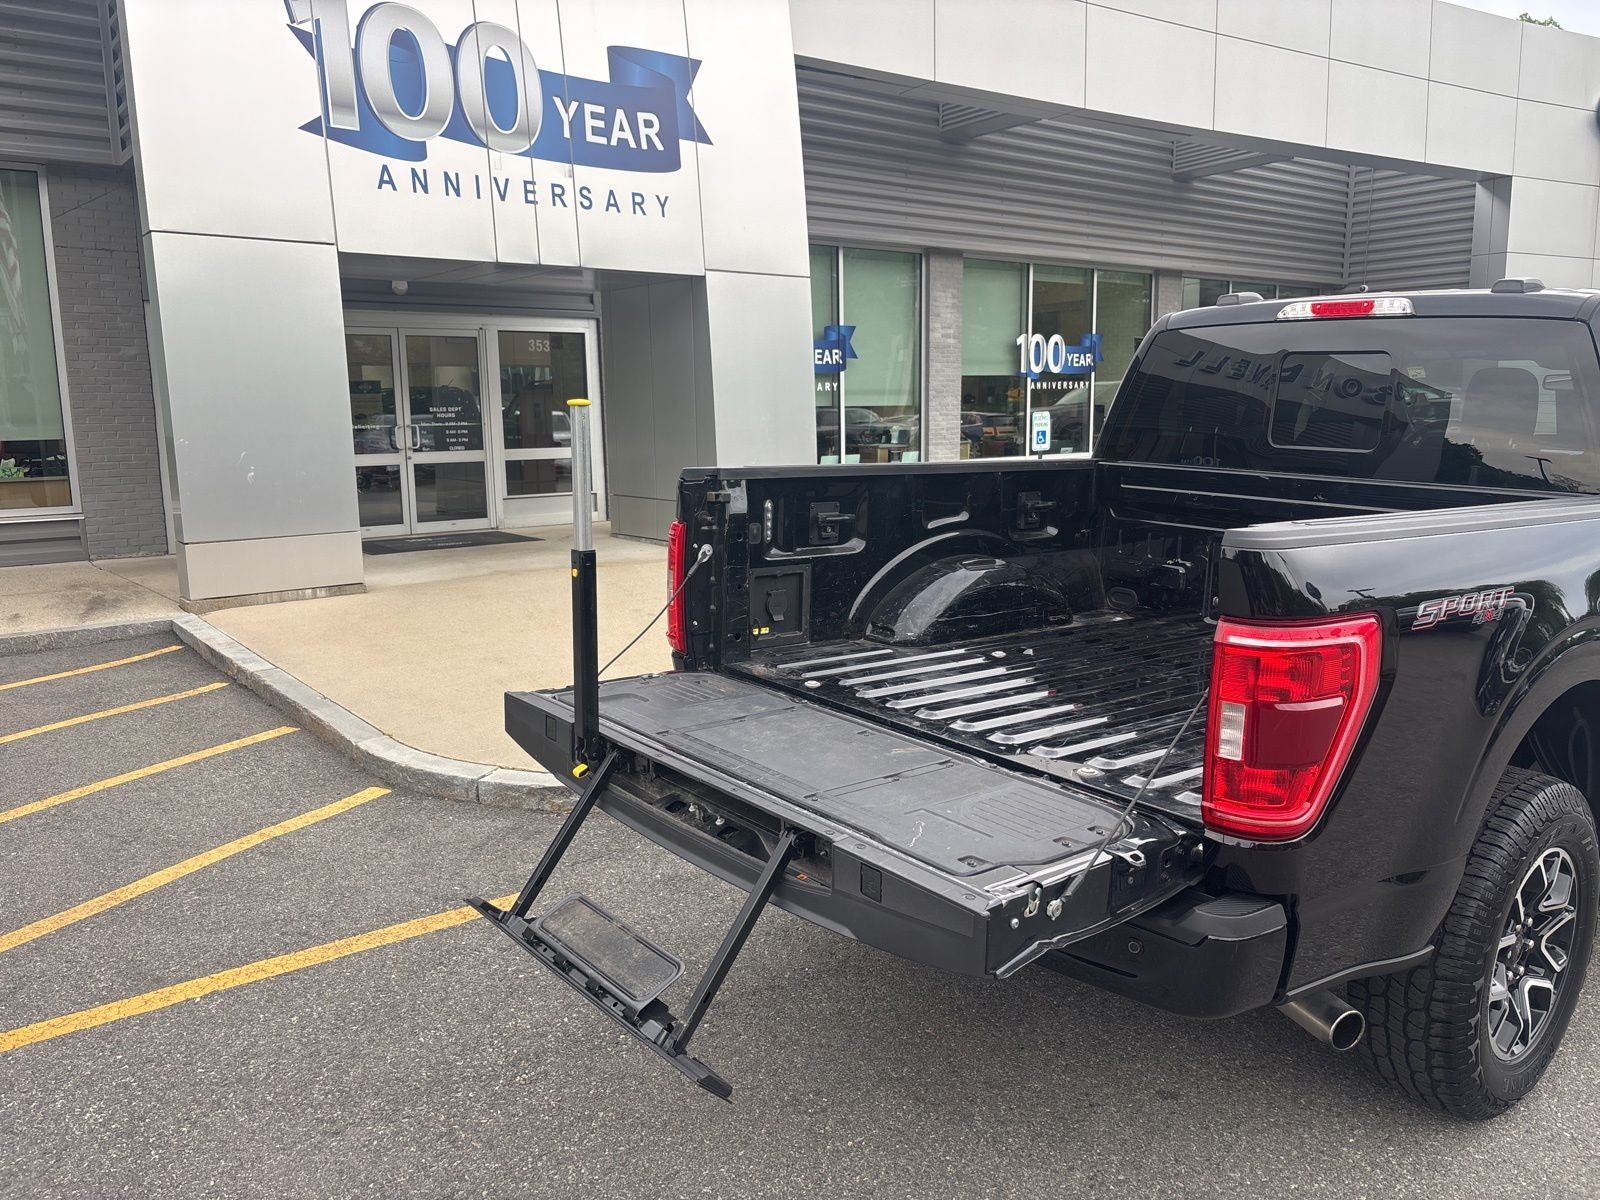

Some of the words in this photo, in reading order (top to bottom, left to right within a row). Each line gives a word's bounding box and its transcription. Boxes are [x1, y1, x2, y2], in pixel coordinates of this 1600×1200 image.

[284, 0, 544, 154] 100
[553, 95, 665, 151] YEAR
[377, 164, 670, 218] ANNIVERSARY
[528, 339, 551, 352] 353
[814, 349, 843, 365] EAR
[1016, 333, 1066, 373] 100
[1067, 353, 1094, 367] YEAR
[816, 382, 838, 391] ARY
[1030, 381, 1090, 390] ANNIVERSARY
[1411, 586, 1515, 630] SPORT
